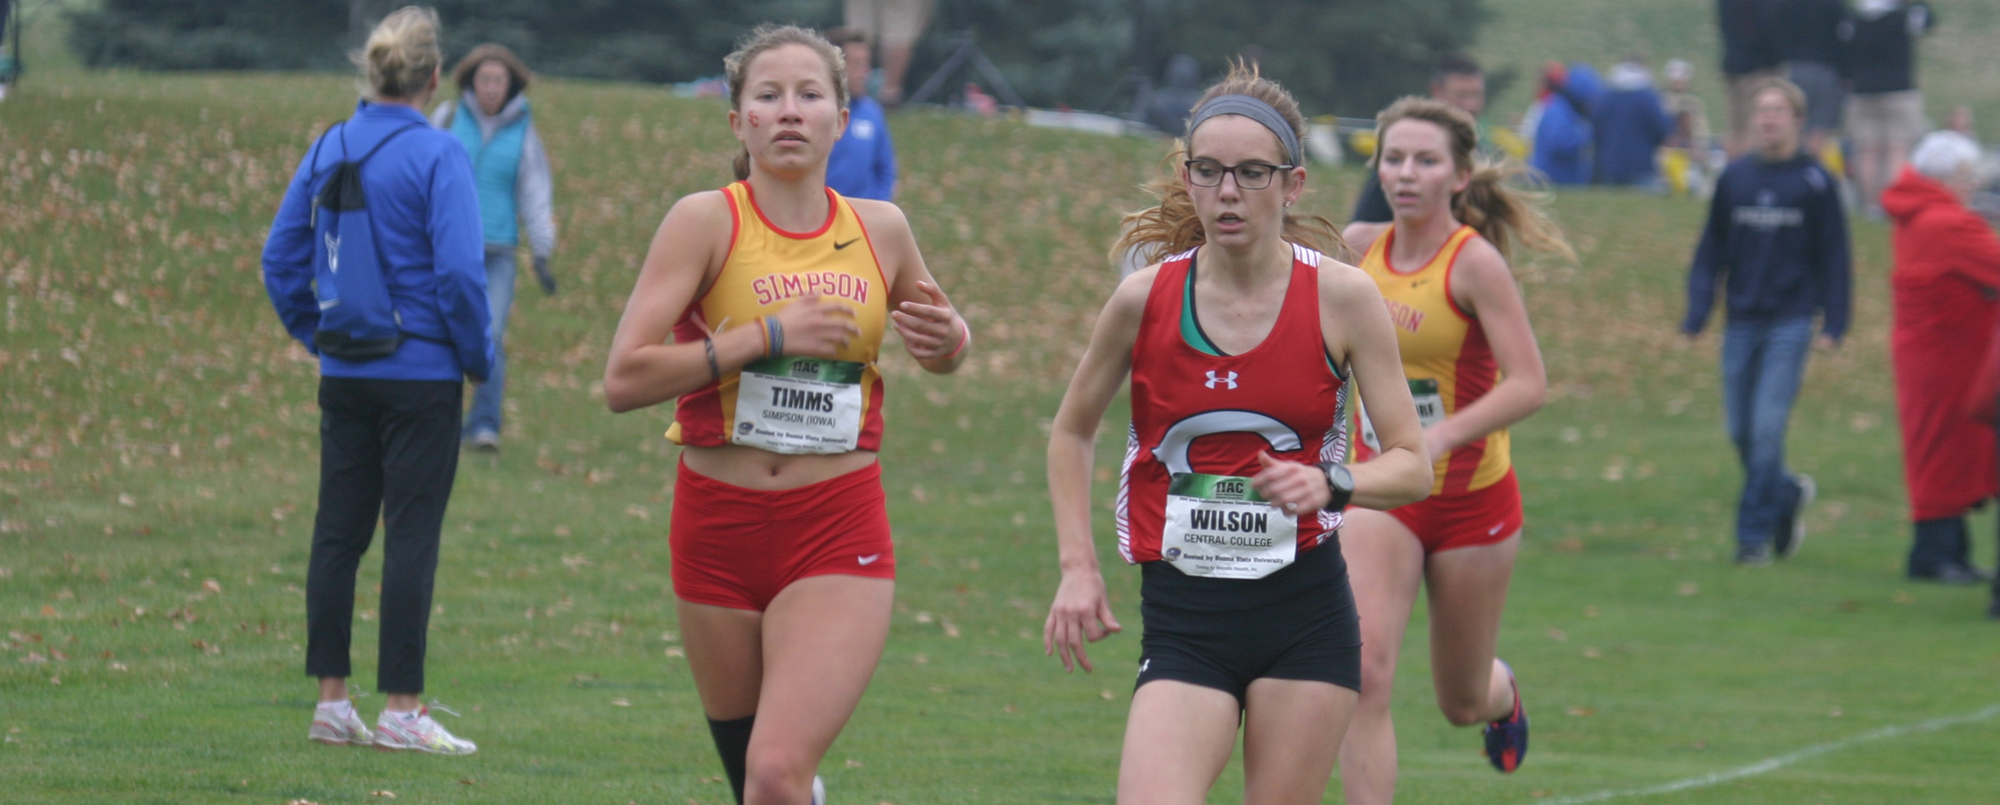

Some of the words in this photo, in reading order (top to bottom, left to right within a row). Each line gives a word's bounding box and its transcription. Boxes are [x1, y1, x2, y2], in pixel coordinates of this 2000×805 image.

[751, 270, 868, 306] SIMPSON
[771, 386, 834, 413] TIMMS
[762, 409, 804, 424] SIMPSON
[806, 414, 836, 428] (IOWA)
[1415, 403, 1435, 417] RF
[1190, 508, 1268, 534] WILSON
[1184, 533, 1227, 545] CENTRAL
[1230, 536, 1273, 548] COLLEGE
[1183, 553, 1204, 561] Hosted
[1205, 555, 1213, 563] by
[1236, 556, 1252, 564] Vista
[1253, 557, 1284, 565] University
